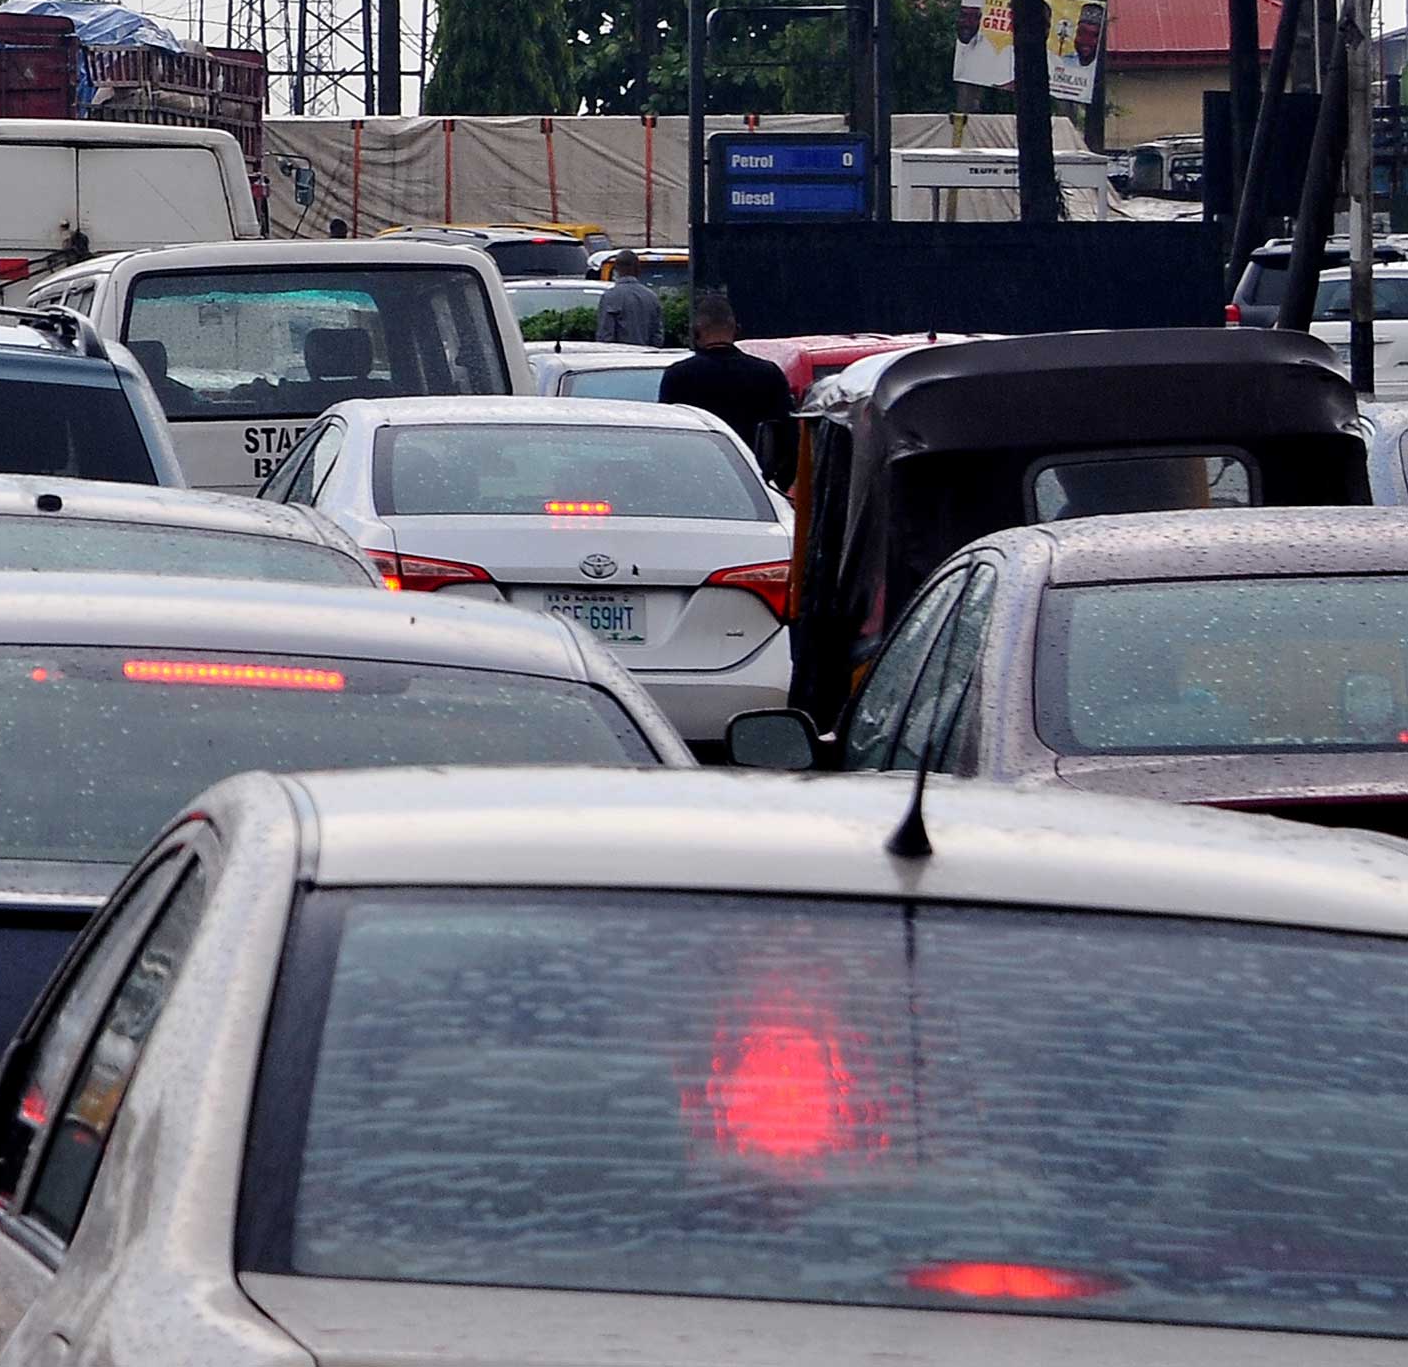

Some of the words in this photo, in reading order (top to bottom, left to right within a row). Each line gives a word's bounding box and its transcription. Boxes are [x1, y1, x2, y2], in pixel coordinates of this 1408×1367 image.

[731, 152, 773, 169] Petrol
[842, 152, 853, 168] 0
[731, 190, 774, 207] Diesel
